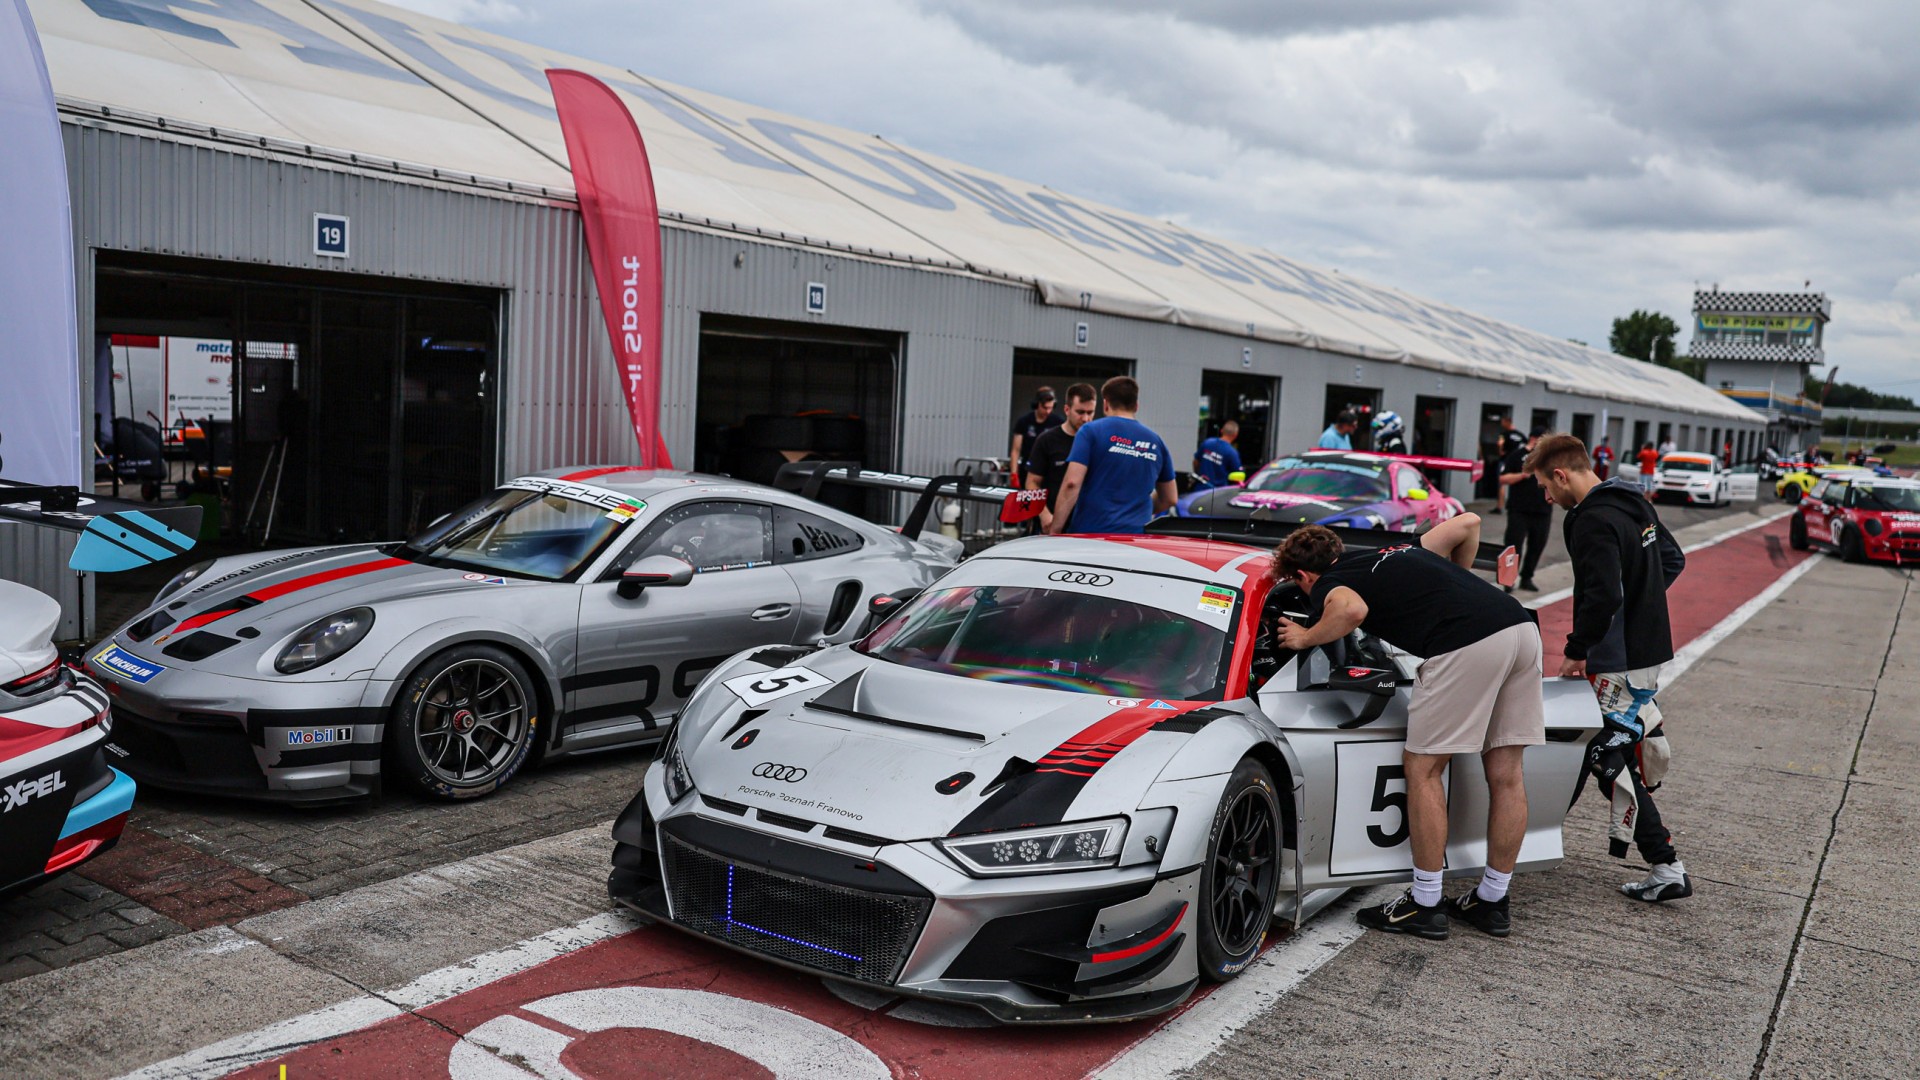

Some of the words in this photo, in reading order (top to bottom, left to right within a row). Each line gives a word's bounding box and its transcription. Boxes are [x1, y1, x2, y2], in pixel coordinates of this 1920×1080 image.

[322, 227, 341, 245] 19
[811, 292, 821, 307] 18
[197, 342, 232, 352] matr
[1016, 488, 1048, 503] #PSCCE
[109, 656, 153, 677] MICHELIN
[750, 674, 809, 695] 5
[1377, 680, 1395, 688] Audi
[288, 728, 334, 745] Mobil
[4, 770, 66, 813] XPEL
[738, 785, 776, 798] Porsche
[777, 792, 816, 808] Poznań
[816, 802, 863, 821] Franowo
[1366, 765, 1409, 848] 5
